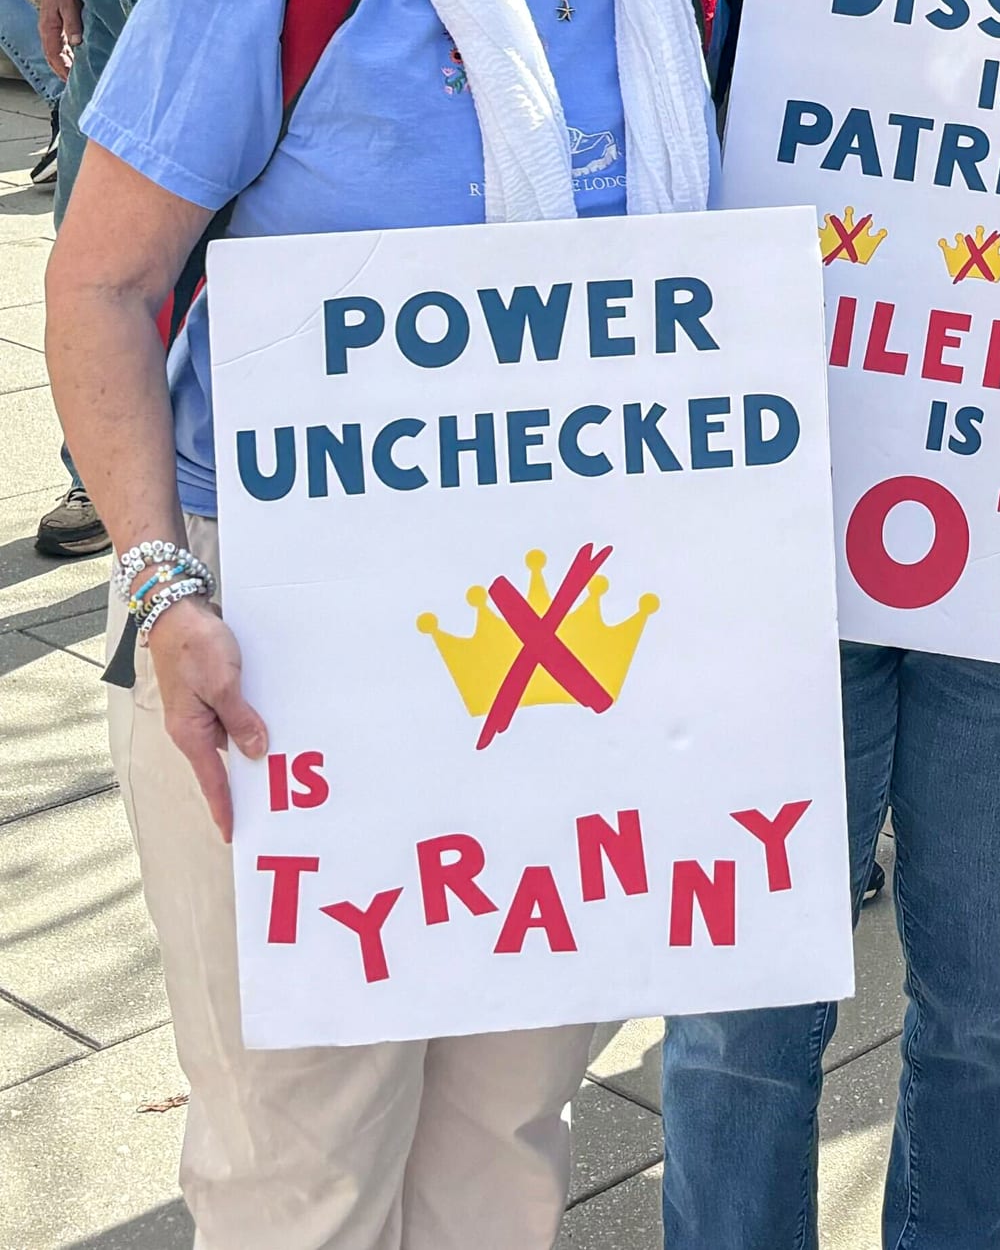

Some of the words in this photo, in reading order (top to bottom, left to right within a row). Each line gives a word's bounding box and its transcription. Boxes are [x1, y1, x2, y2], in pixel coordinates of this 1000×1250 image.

[324, 277, 719, 375] POWER
[236, 394, 800, 502] UNCHECKED
[926, 400, 984, 455] IS
[268, 751, 329, 812] IS
[257, 800, 812, 983] TYRANNY
